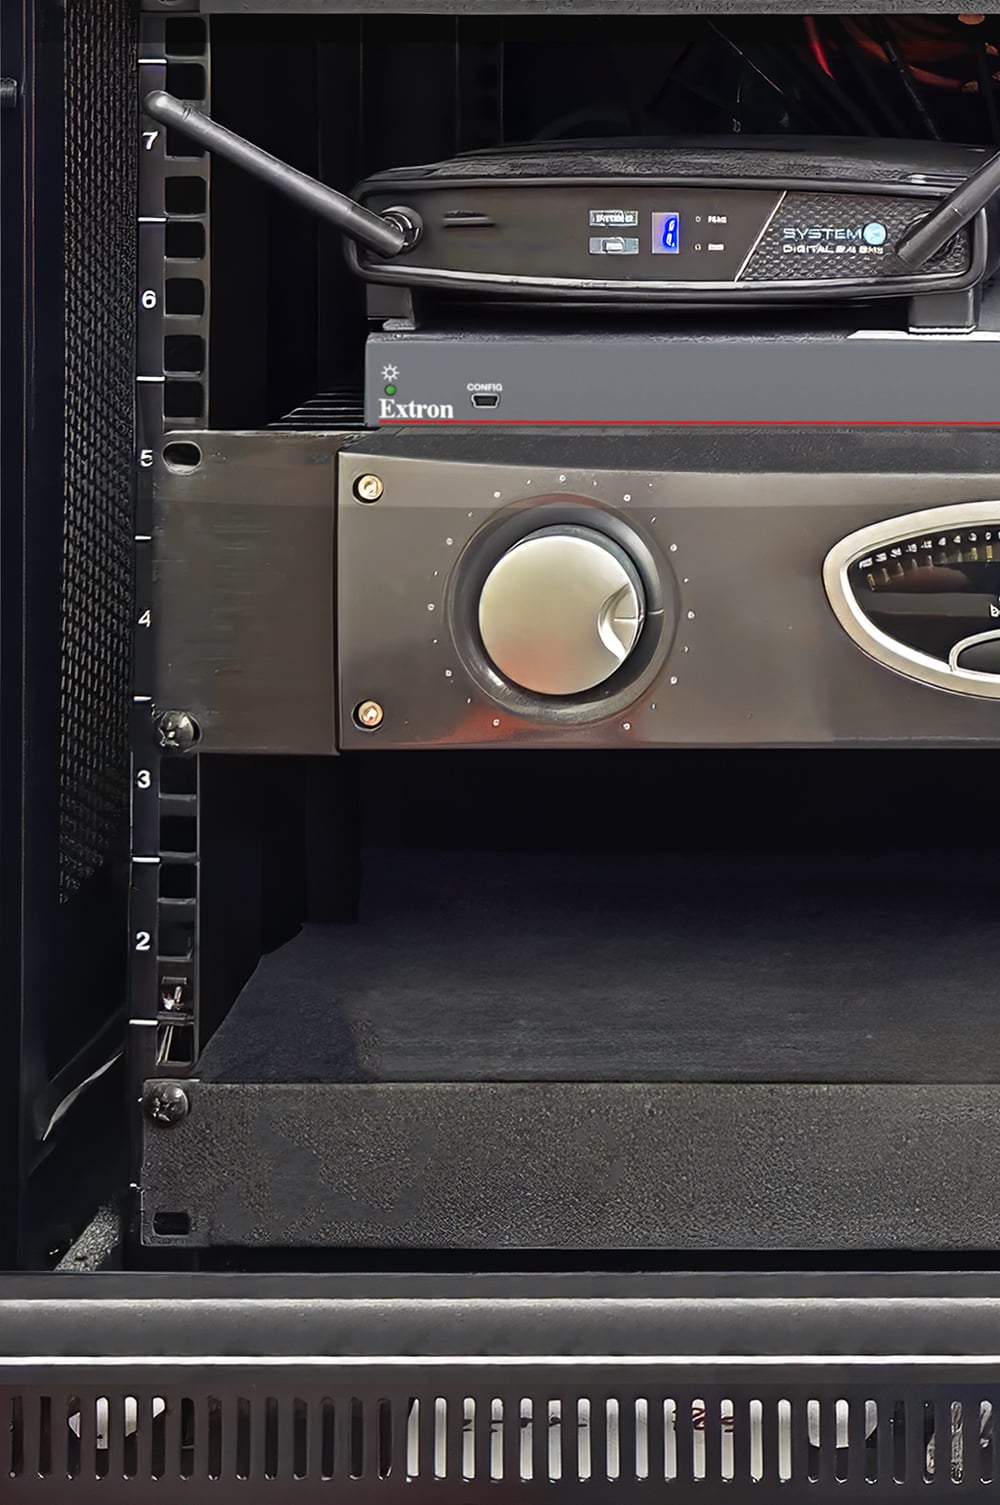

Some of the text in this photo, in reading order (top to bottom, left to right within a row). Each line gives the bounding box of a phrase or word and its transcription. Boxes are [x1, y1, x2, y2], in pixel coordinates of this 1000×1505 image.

[142, 131, 159, 150] 7
[783, 227, 862, 240] SYSTEM
[141, 289, 158, 310] 6
[467, 383, 503, 392] CONFIG
[378, 398, 454, 420] Extron
[139, 448, 155, 467] 5
[137, 608, 152, 627] 4
[136, 769, 151, 789] 3
[135, 931, 151, 951] 2
